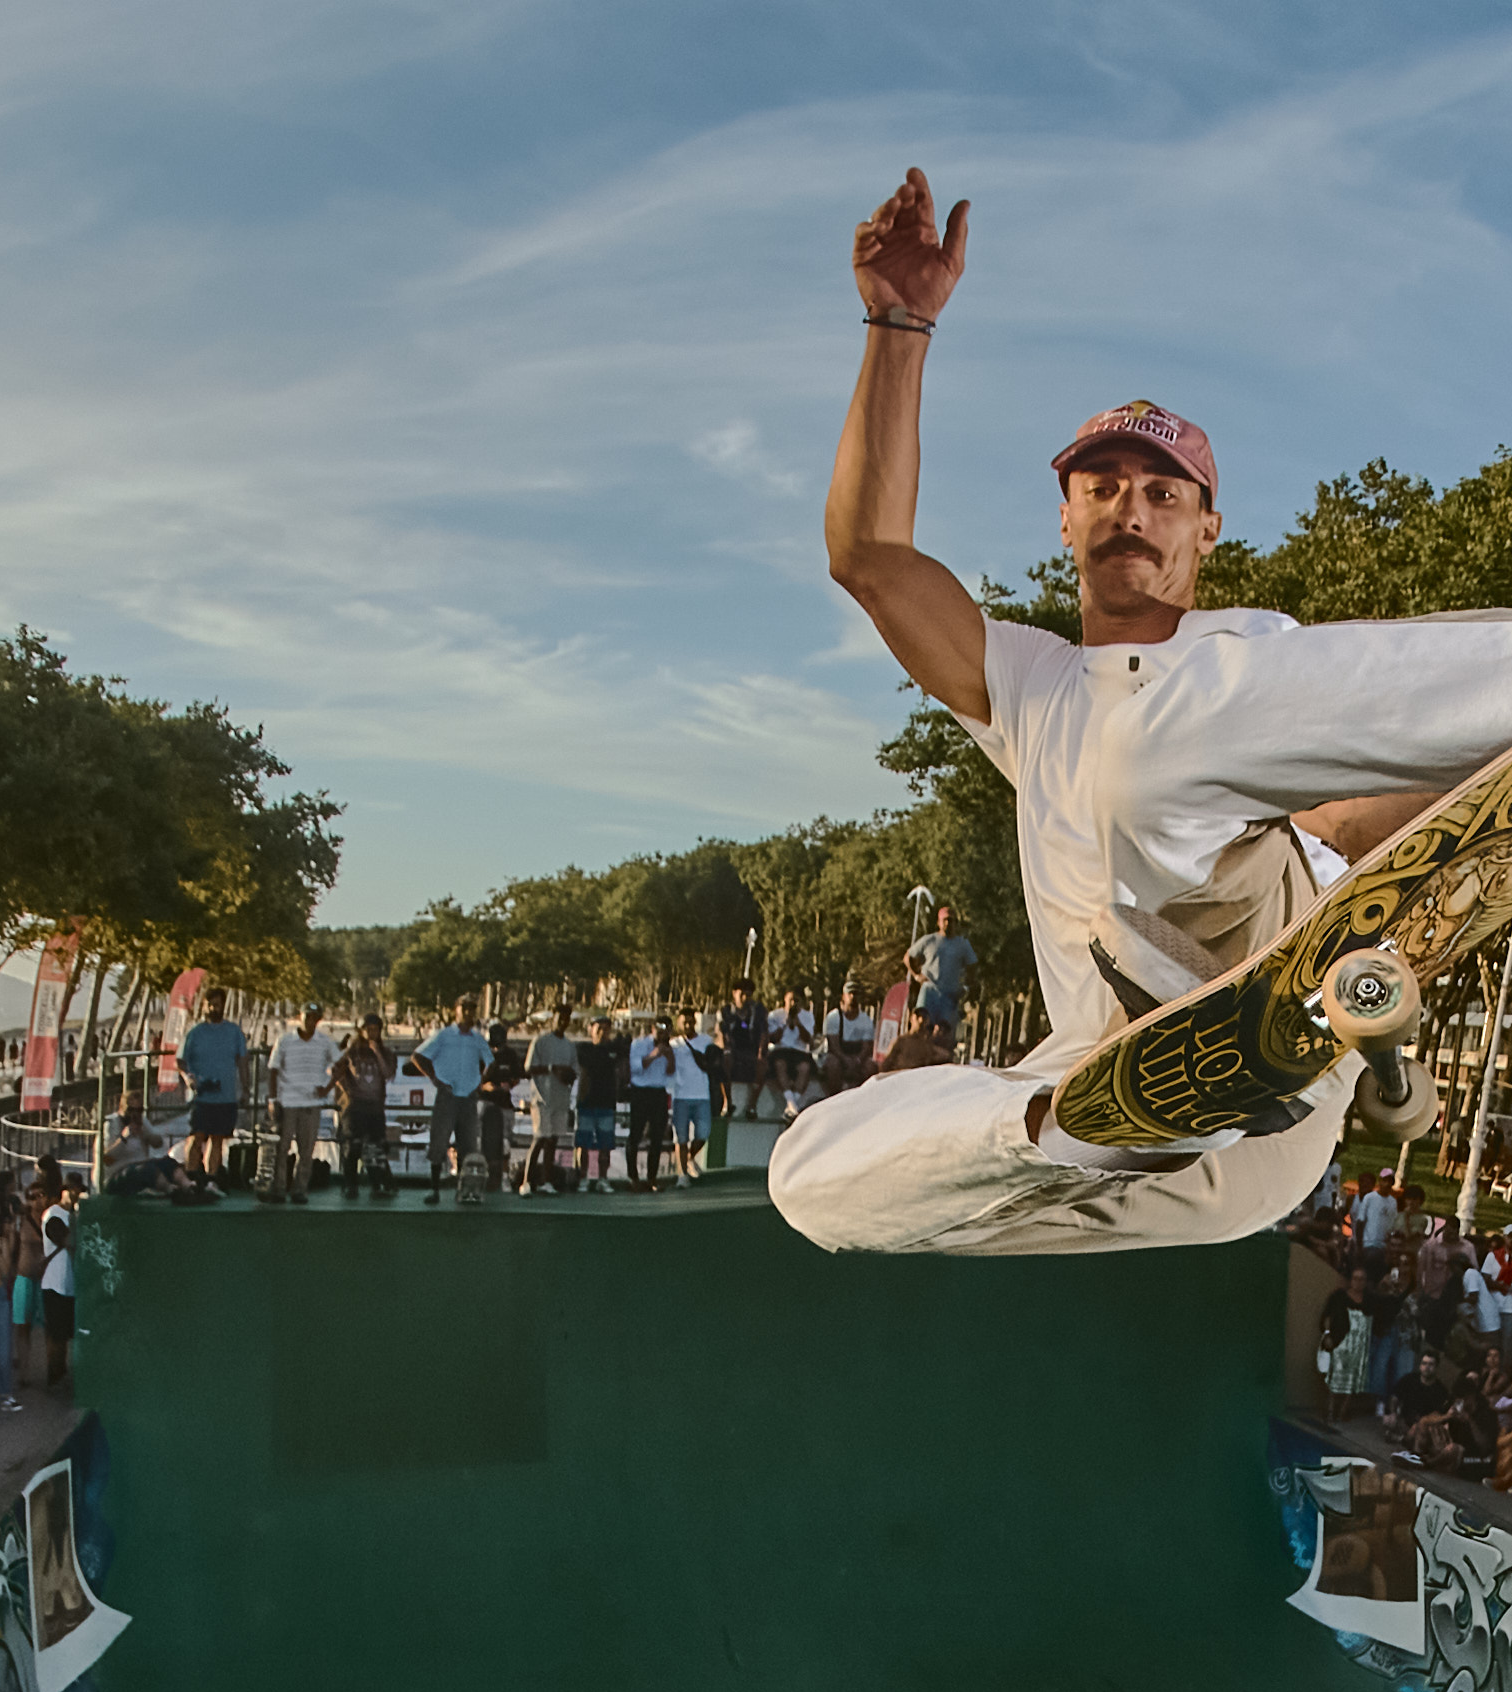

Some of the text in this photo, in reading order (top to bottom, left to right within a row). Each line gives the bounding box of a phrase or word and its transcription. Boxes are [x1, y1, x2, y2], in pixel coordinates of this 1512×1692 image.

[1093, 417, 1177, 445] Red Bull
[1138, 1013, 1254, 1135] DANNY
